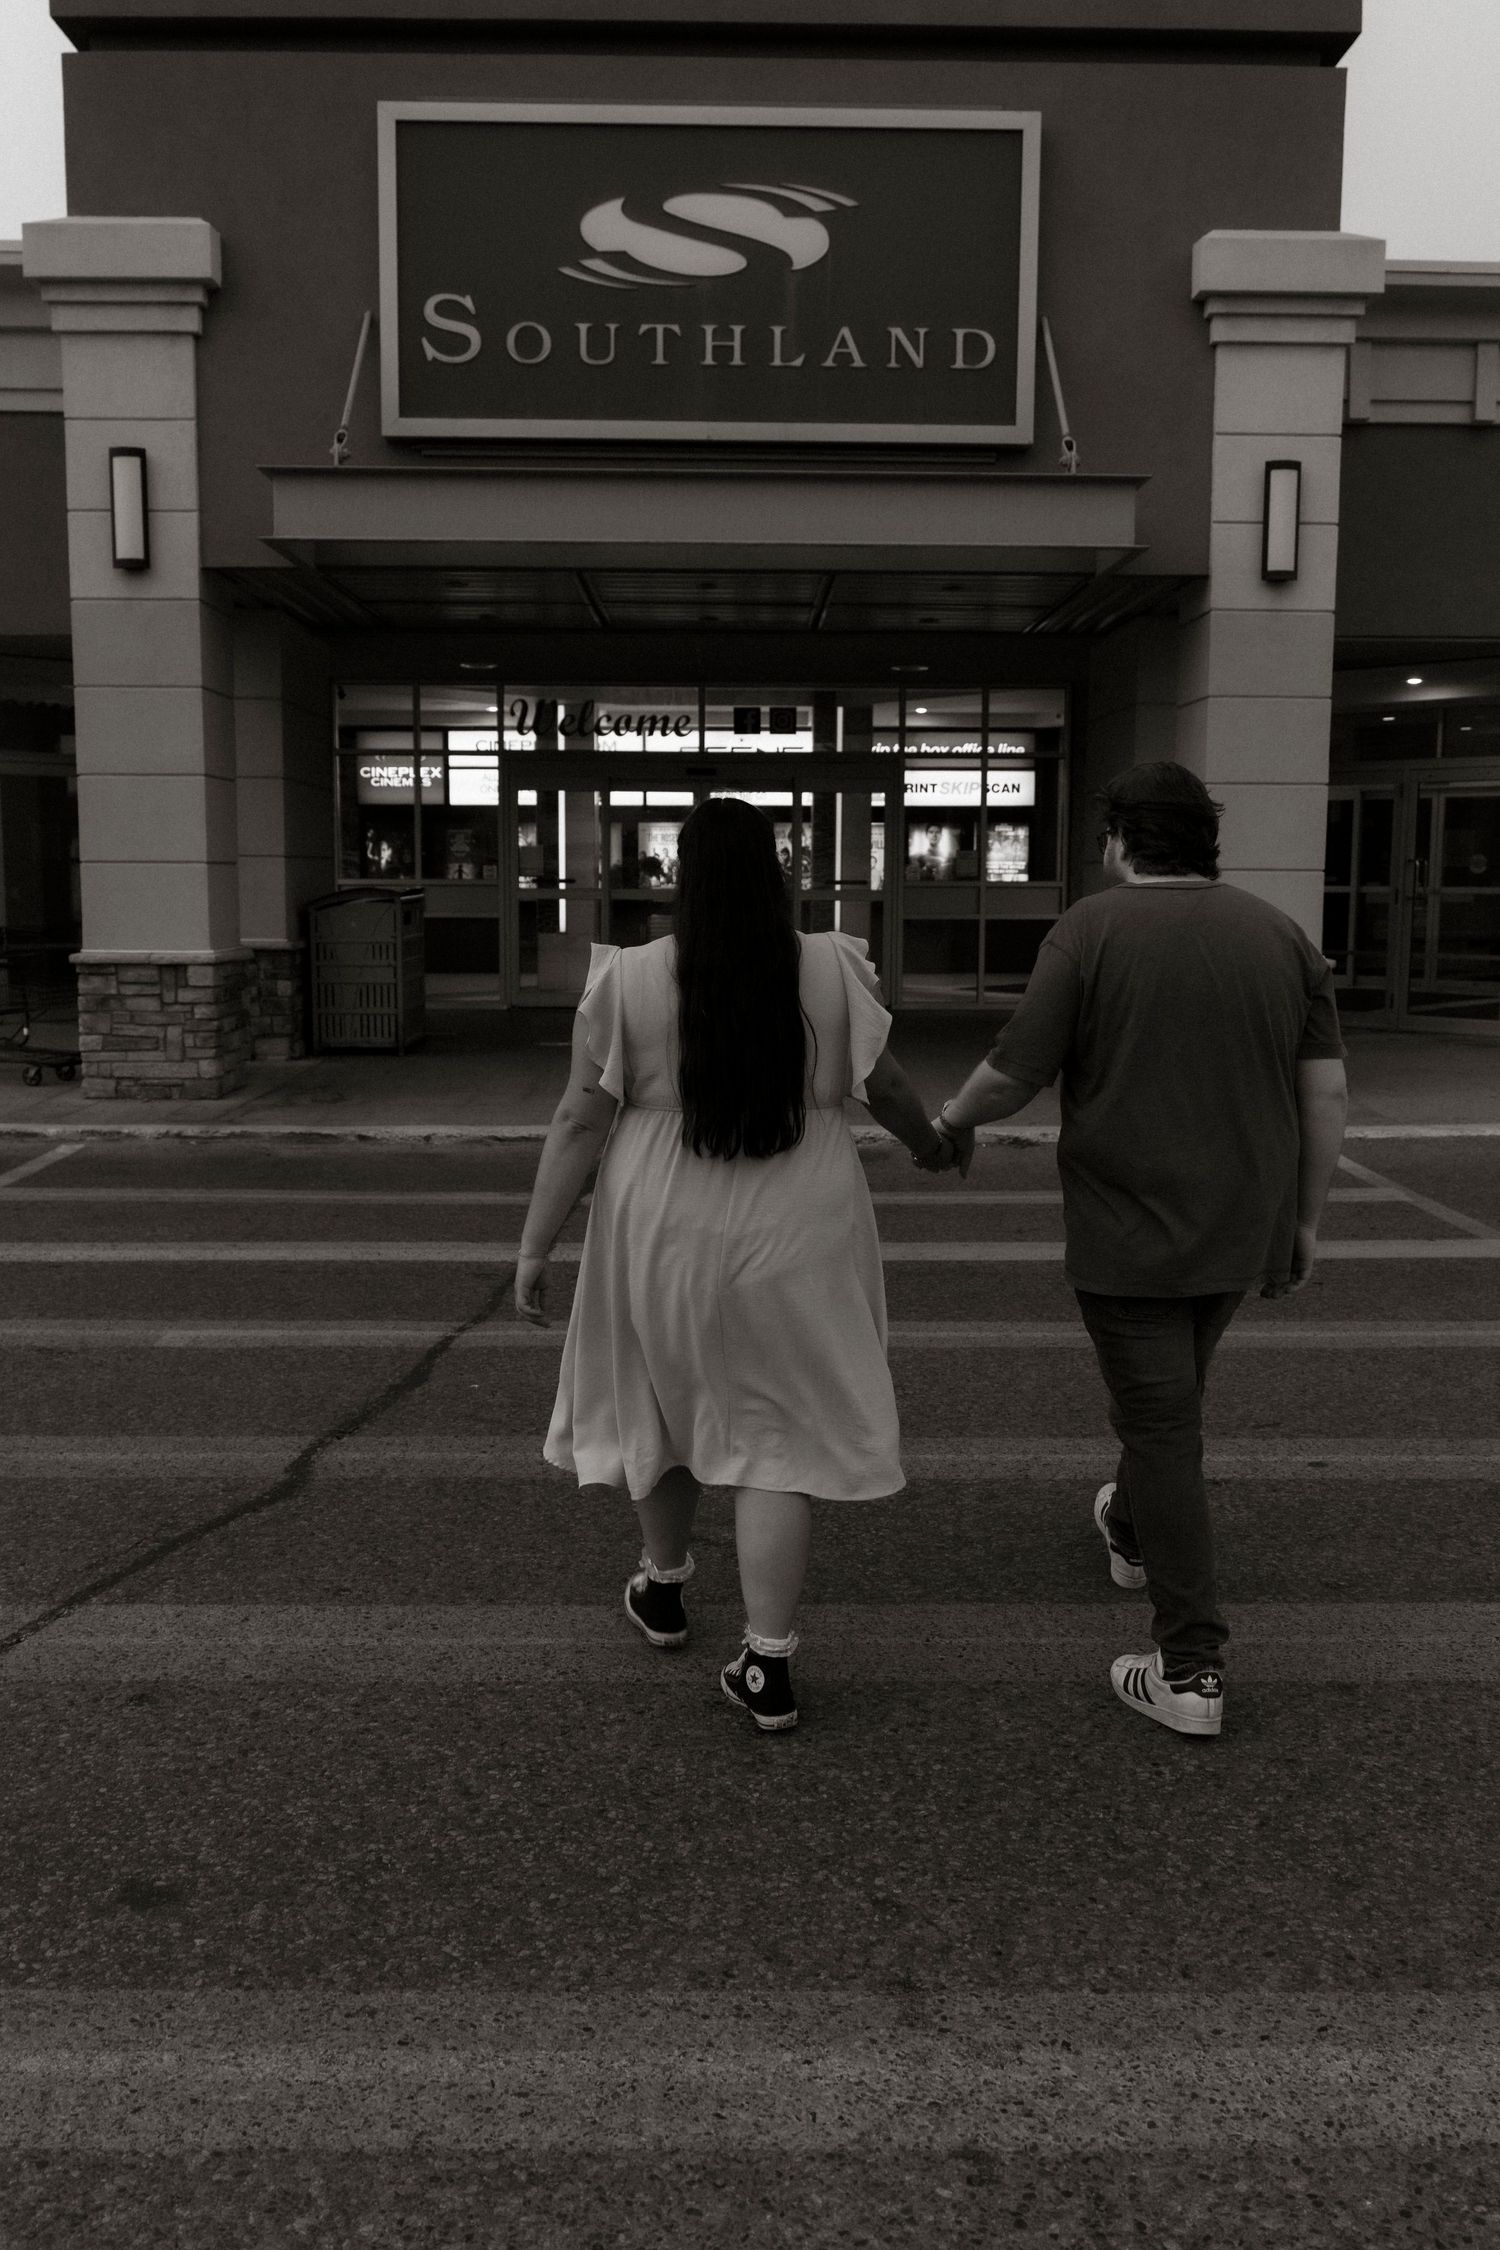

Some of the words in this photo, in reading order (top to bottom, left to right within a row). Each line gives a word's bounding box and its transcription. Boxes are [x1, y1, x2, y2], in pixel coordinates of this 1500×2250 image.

[421, 292, 999, 371] SOUTHLAND
[510, 698, 693, 737] Welcome
[359, 766, 443, 778] CINEPLEX
[370, 777, 433, 787] CINEMS
[903, 783, 938, 793] RINT
[939, 782, 981, 795] SKIP
